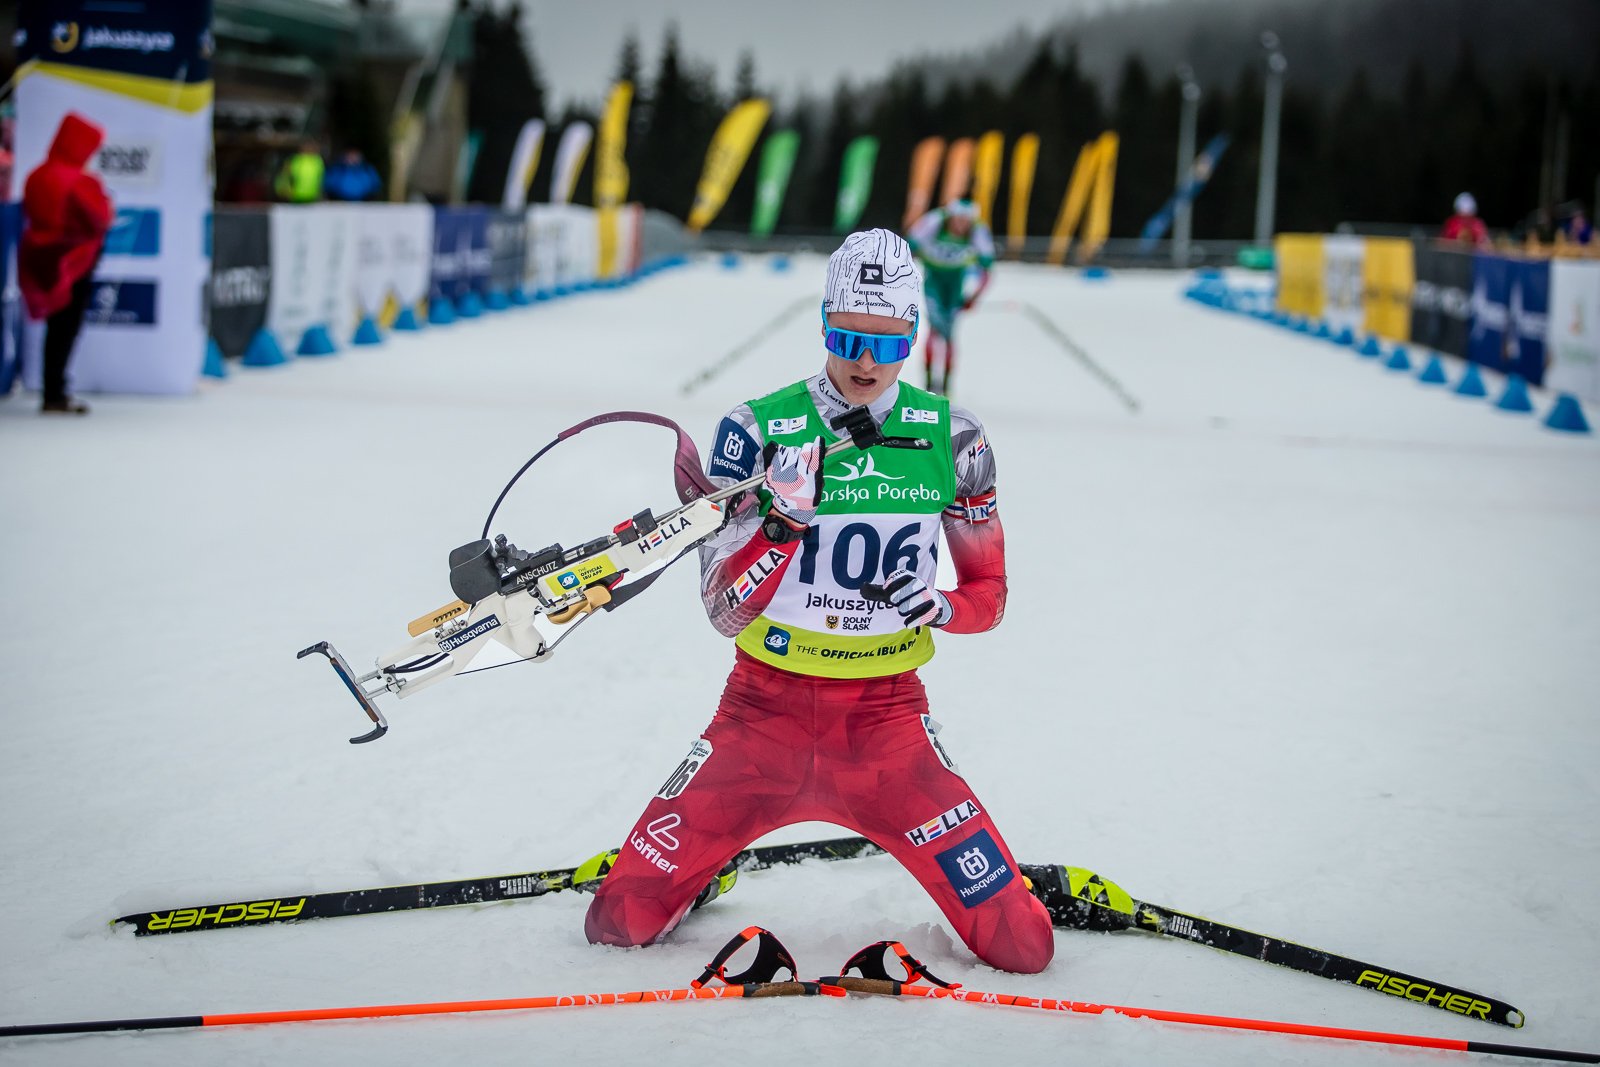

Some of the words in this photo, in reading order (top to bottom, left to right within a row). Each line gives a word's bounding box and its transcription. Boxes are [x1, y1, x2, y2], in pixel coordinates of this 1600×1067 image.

[713, 456, 748, 478] Husqvarna
[822, 483, 870, 505] arska
[877, 482, 941, 503] Poręba
[637, 516, 692, 554] HELLA
[580, 565, 603, 577] OFFICIAL
[798, 521, 922, 591] 106
[723, 548, 787, 610] HELLA
[450, 618, 499, 648] Husqvarna
[843, 616, 873, 624] DOLNY
[795, 644, 819, 656] THE
[820, 648, 875, 660] OFFICIAL
[877, 645, 897, 656] IBU
[657, 758, 699, 798] 06
[908, 801, 980, 847] HELLA
[630, 830, 679, 874] Löffler
[959, 863, 1007, 898] Husqvarna
[147, 897, 307, 932] FISCHER
[1355, 969, 1492, 1020] FISCHER
